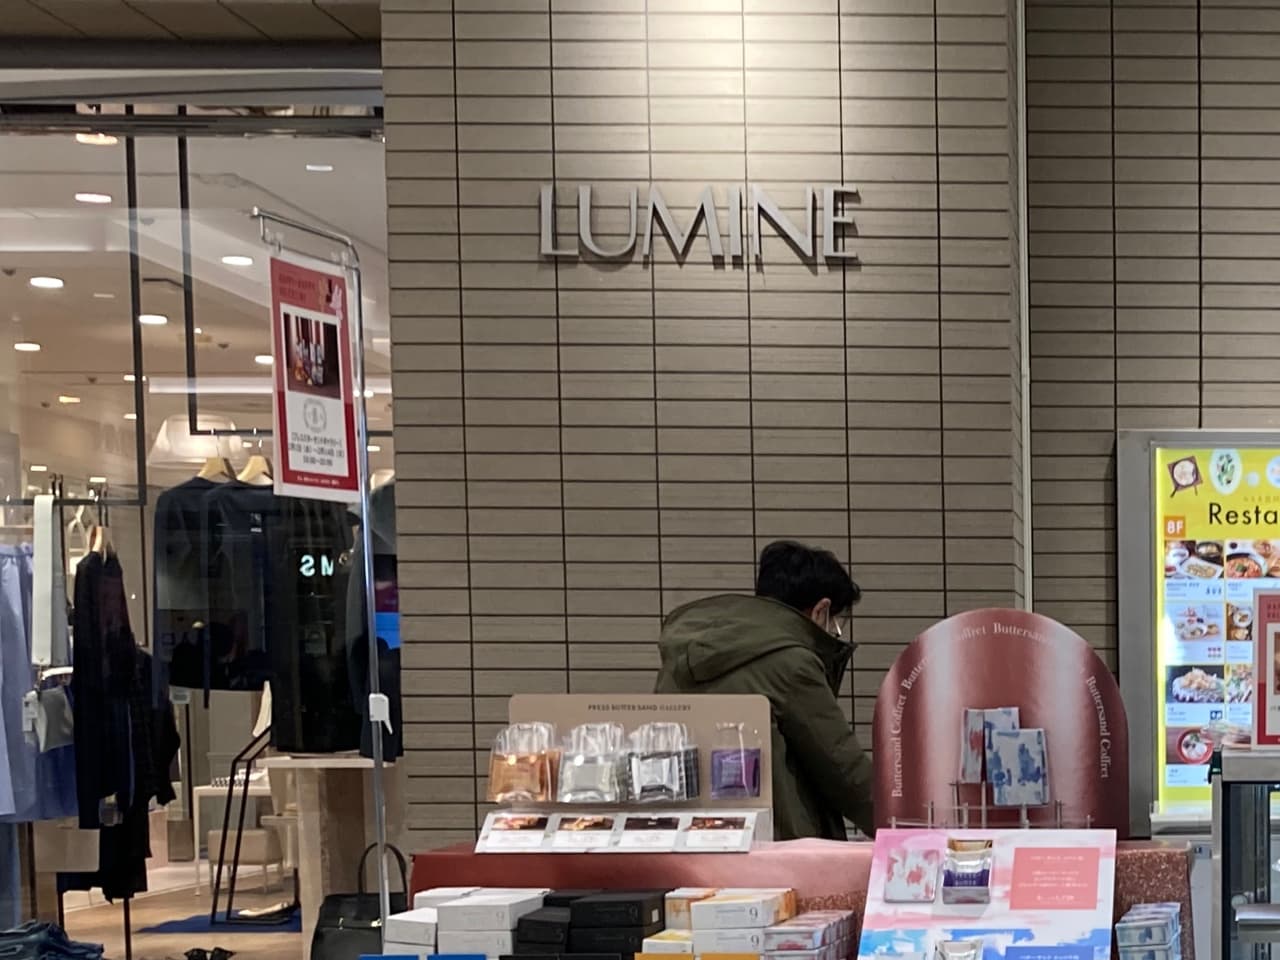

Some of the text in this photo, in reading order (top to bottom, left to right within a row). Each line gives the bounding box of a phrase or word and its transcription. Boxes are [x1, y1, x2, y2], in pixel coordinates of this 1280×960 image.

[540, 184, 857, 258] LUMINE
[1086, 675, 1112, 779] Buttersand Coffret
[892, 740, 903, 798] Buttersand
